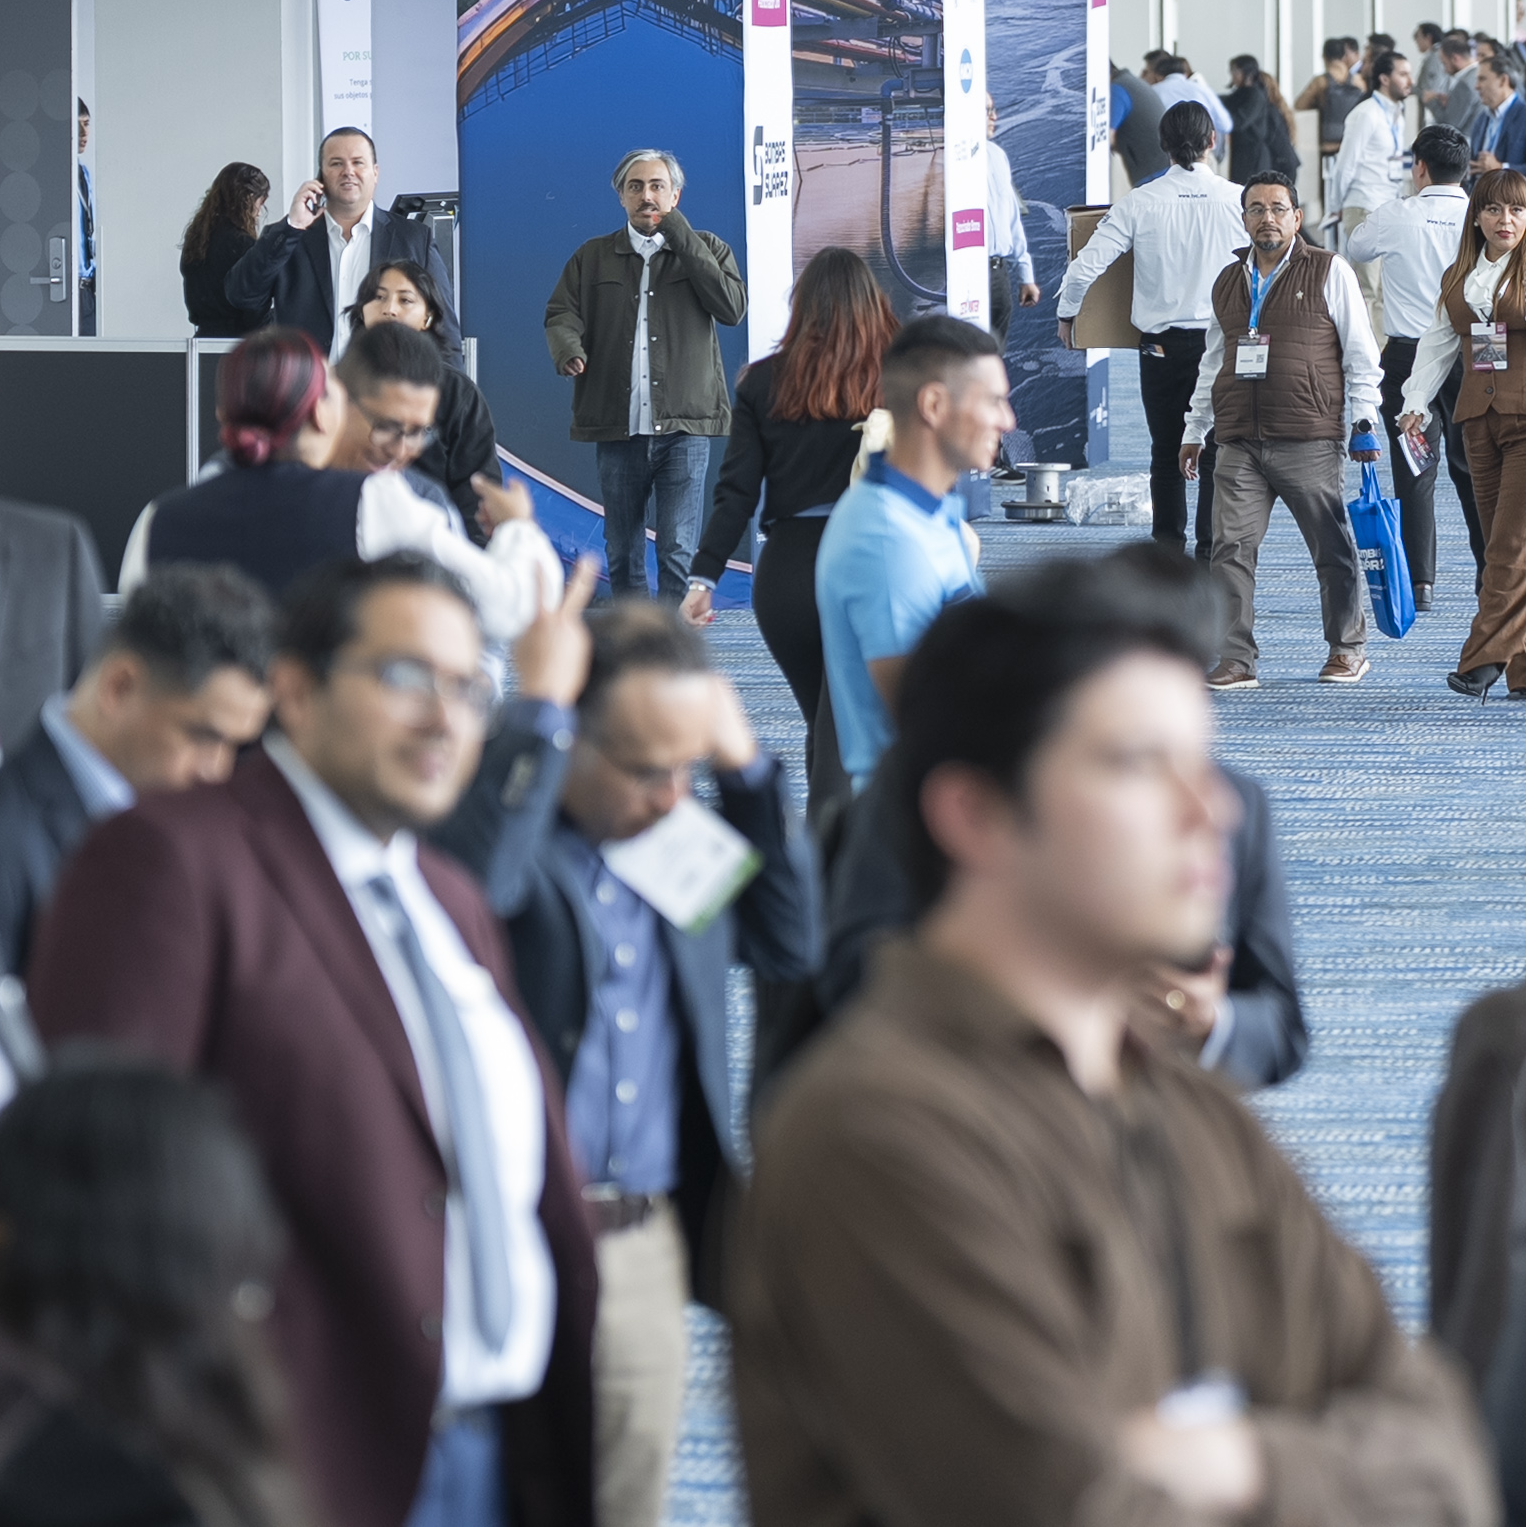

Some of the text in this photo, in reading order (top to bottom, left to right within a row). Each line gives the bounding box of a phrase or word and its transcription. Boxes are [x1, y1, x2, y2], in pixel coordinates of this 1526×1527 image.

[342, 51, 361, 61] POR
[349, 79, 368, 87] Tenga
[345, 91, 368, 101] objetos
